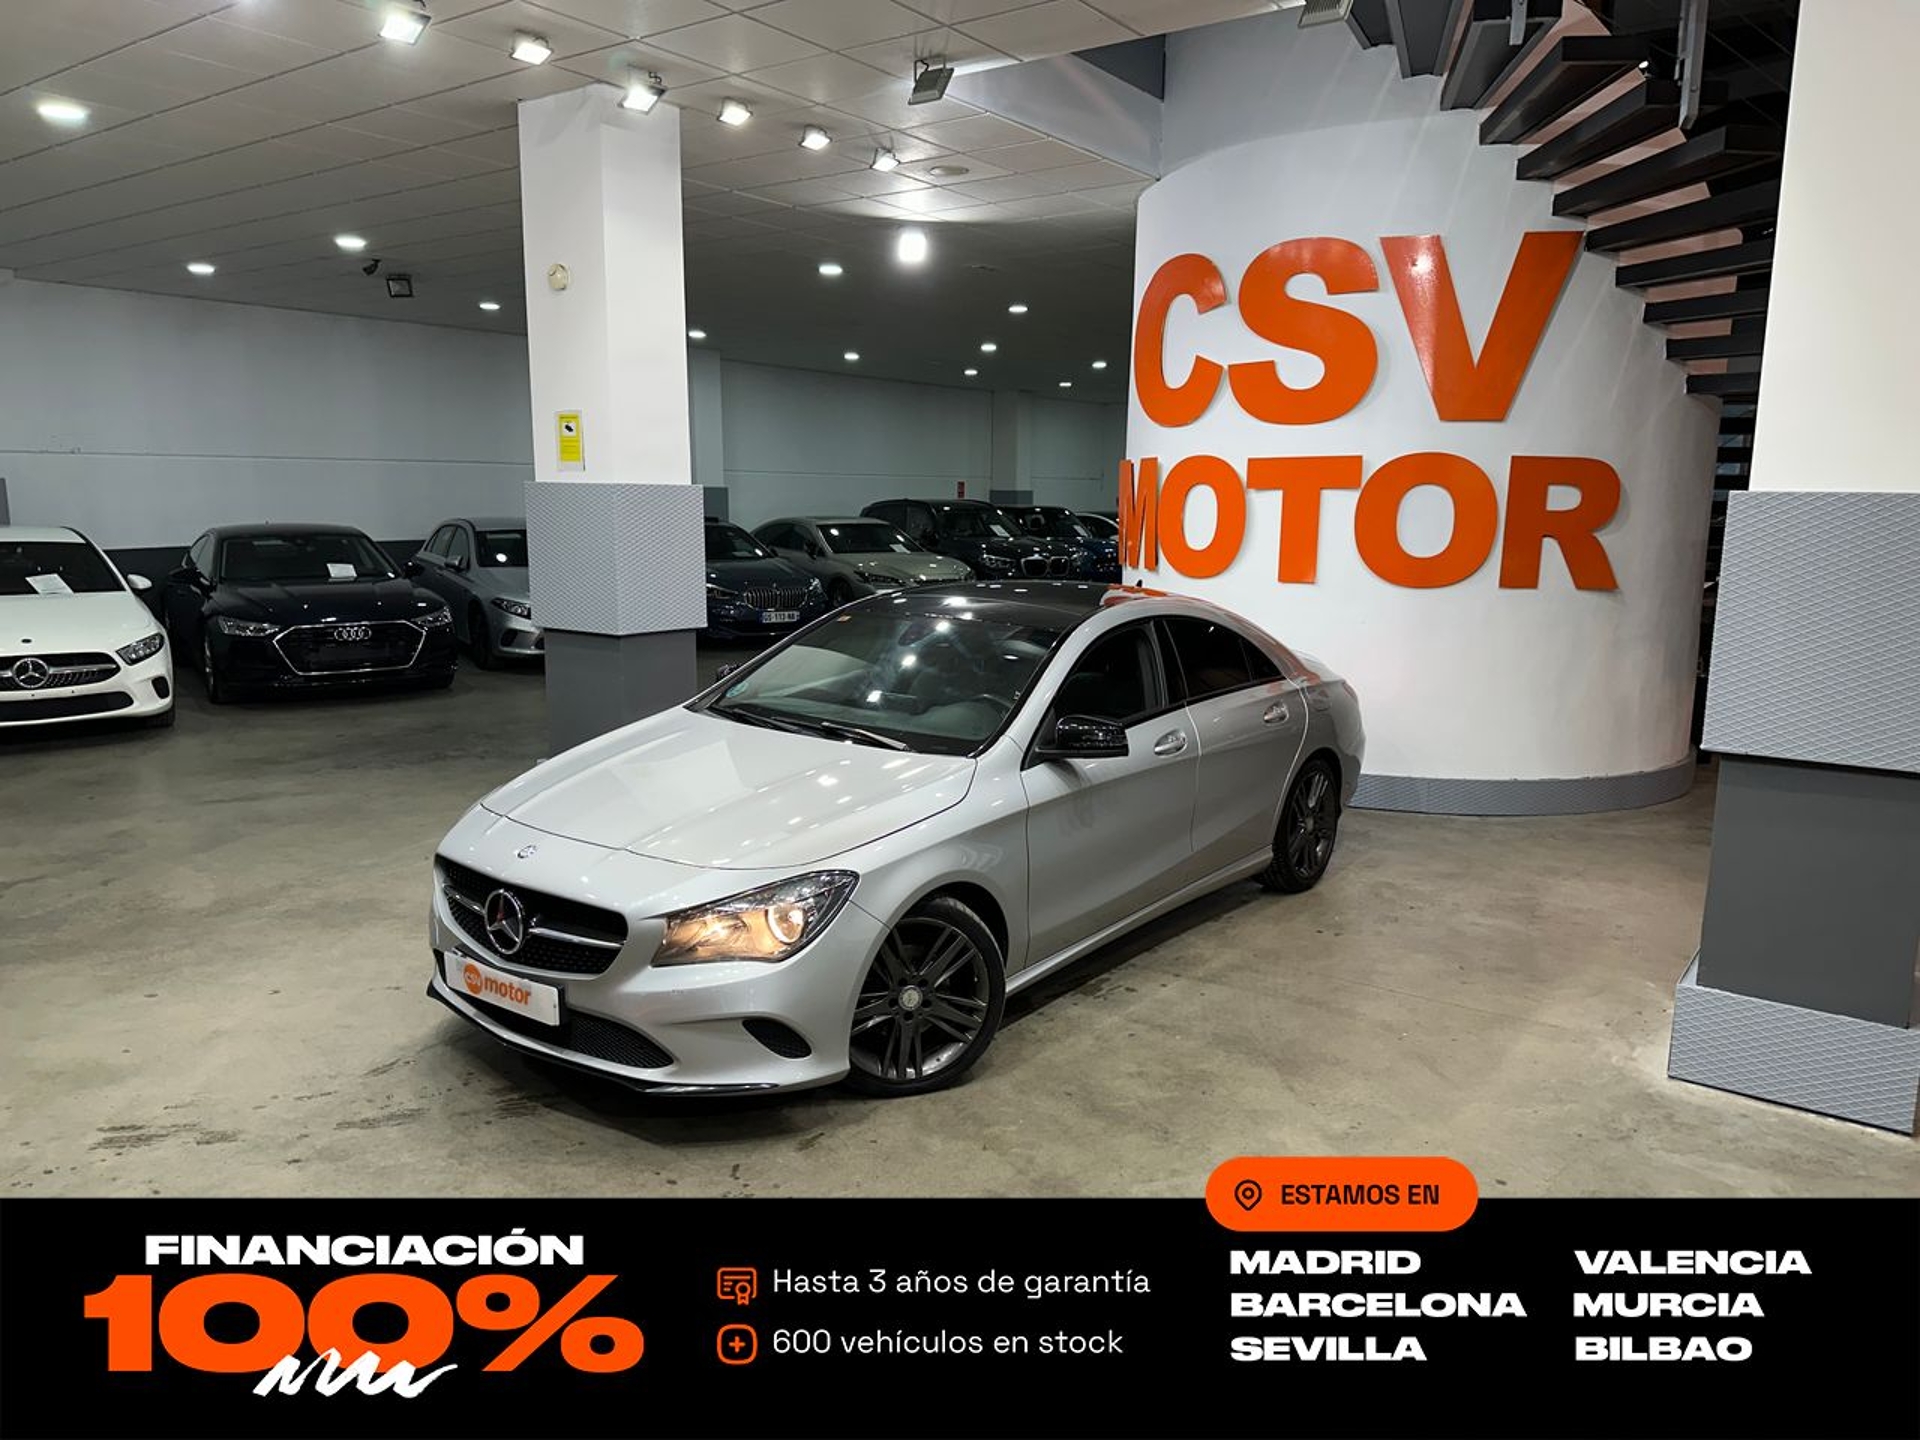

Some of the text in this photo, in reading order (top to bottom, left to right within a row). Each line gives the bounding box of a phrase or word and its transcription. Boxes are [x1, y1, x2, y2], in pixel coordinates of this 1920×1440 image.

[1134, 231, 1584, 427] CSV
[1119, 452, 1621, 591] MOTOR
[484, 977, 532, 1005] motor
